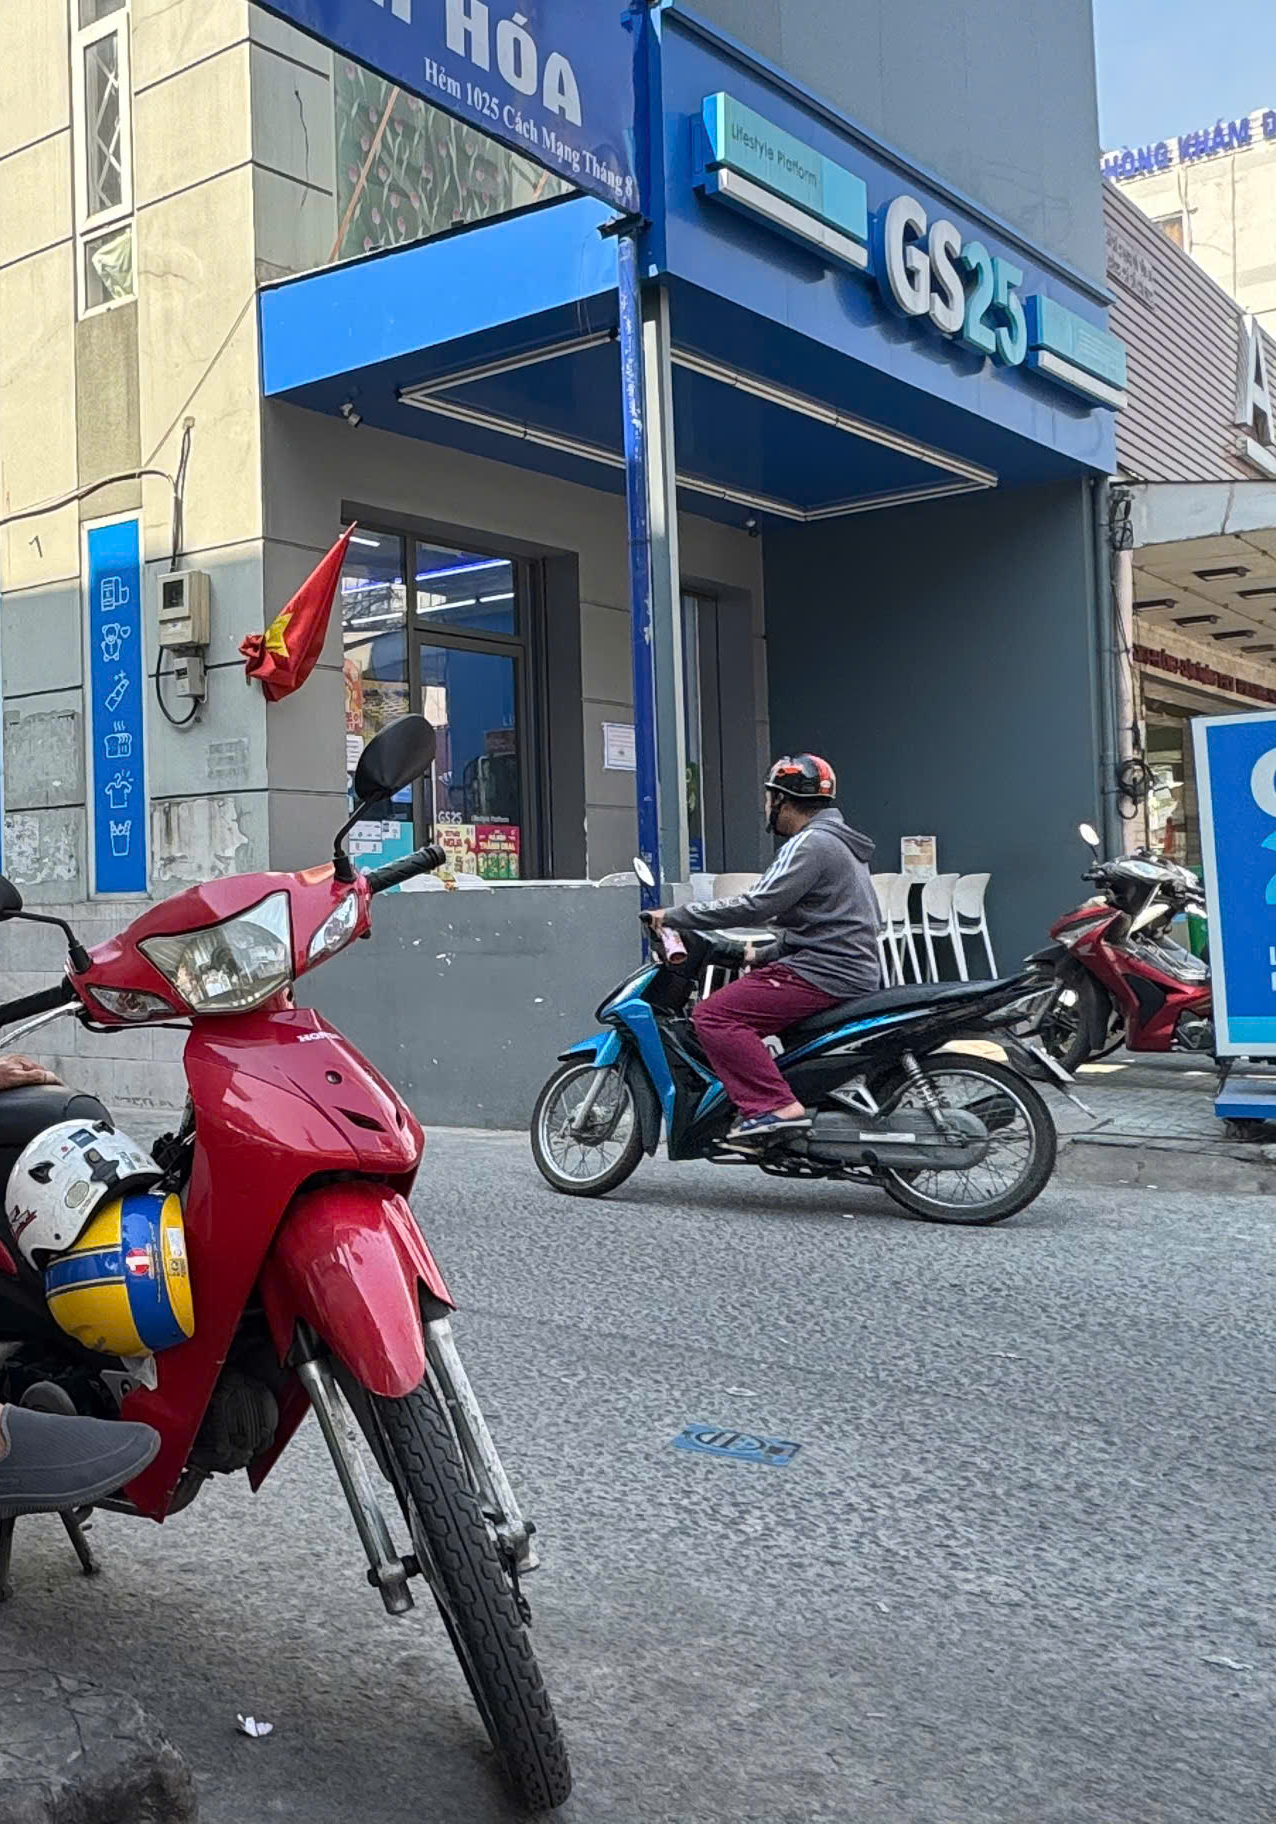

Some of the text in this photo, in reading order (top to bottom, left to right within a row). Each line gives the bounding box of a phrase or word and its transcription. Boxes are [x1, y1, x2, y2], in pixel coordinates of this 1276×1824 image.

[446, 0, 582, 127] HÓA
[424, 56, 634, 197] Hẻm 1025 Cách Mạng Tháng 8
[731, 122, 818, 189] Lifestyle Platform
[1101, 142, 1169, 177] HÒNG
[1179, 117, 1252, 164] KHÁM
[885, 195, 1028, 367] GS25
[438, 810, 462, 825] GS25
